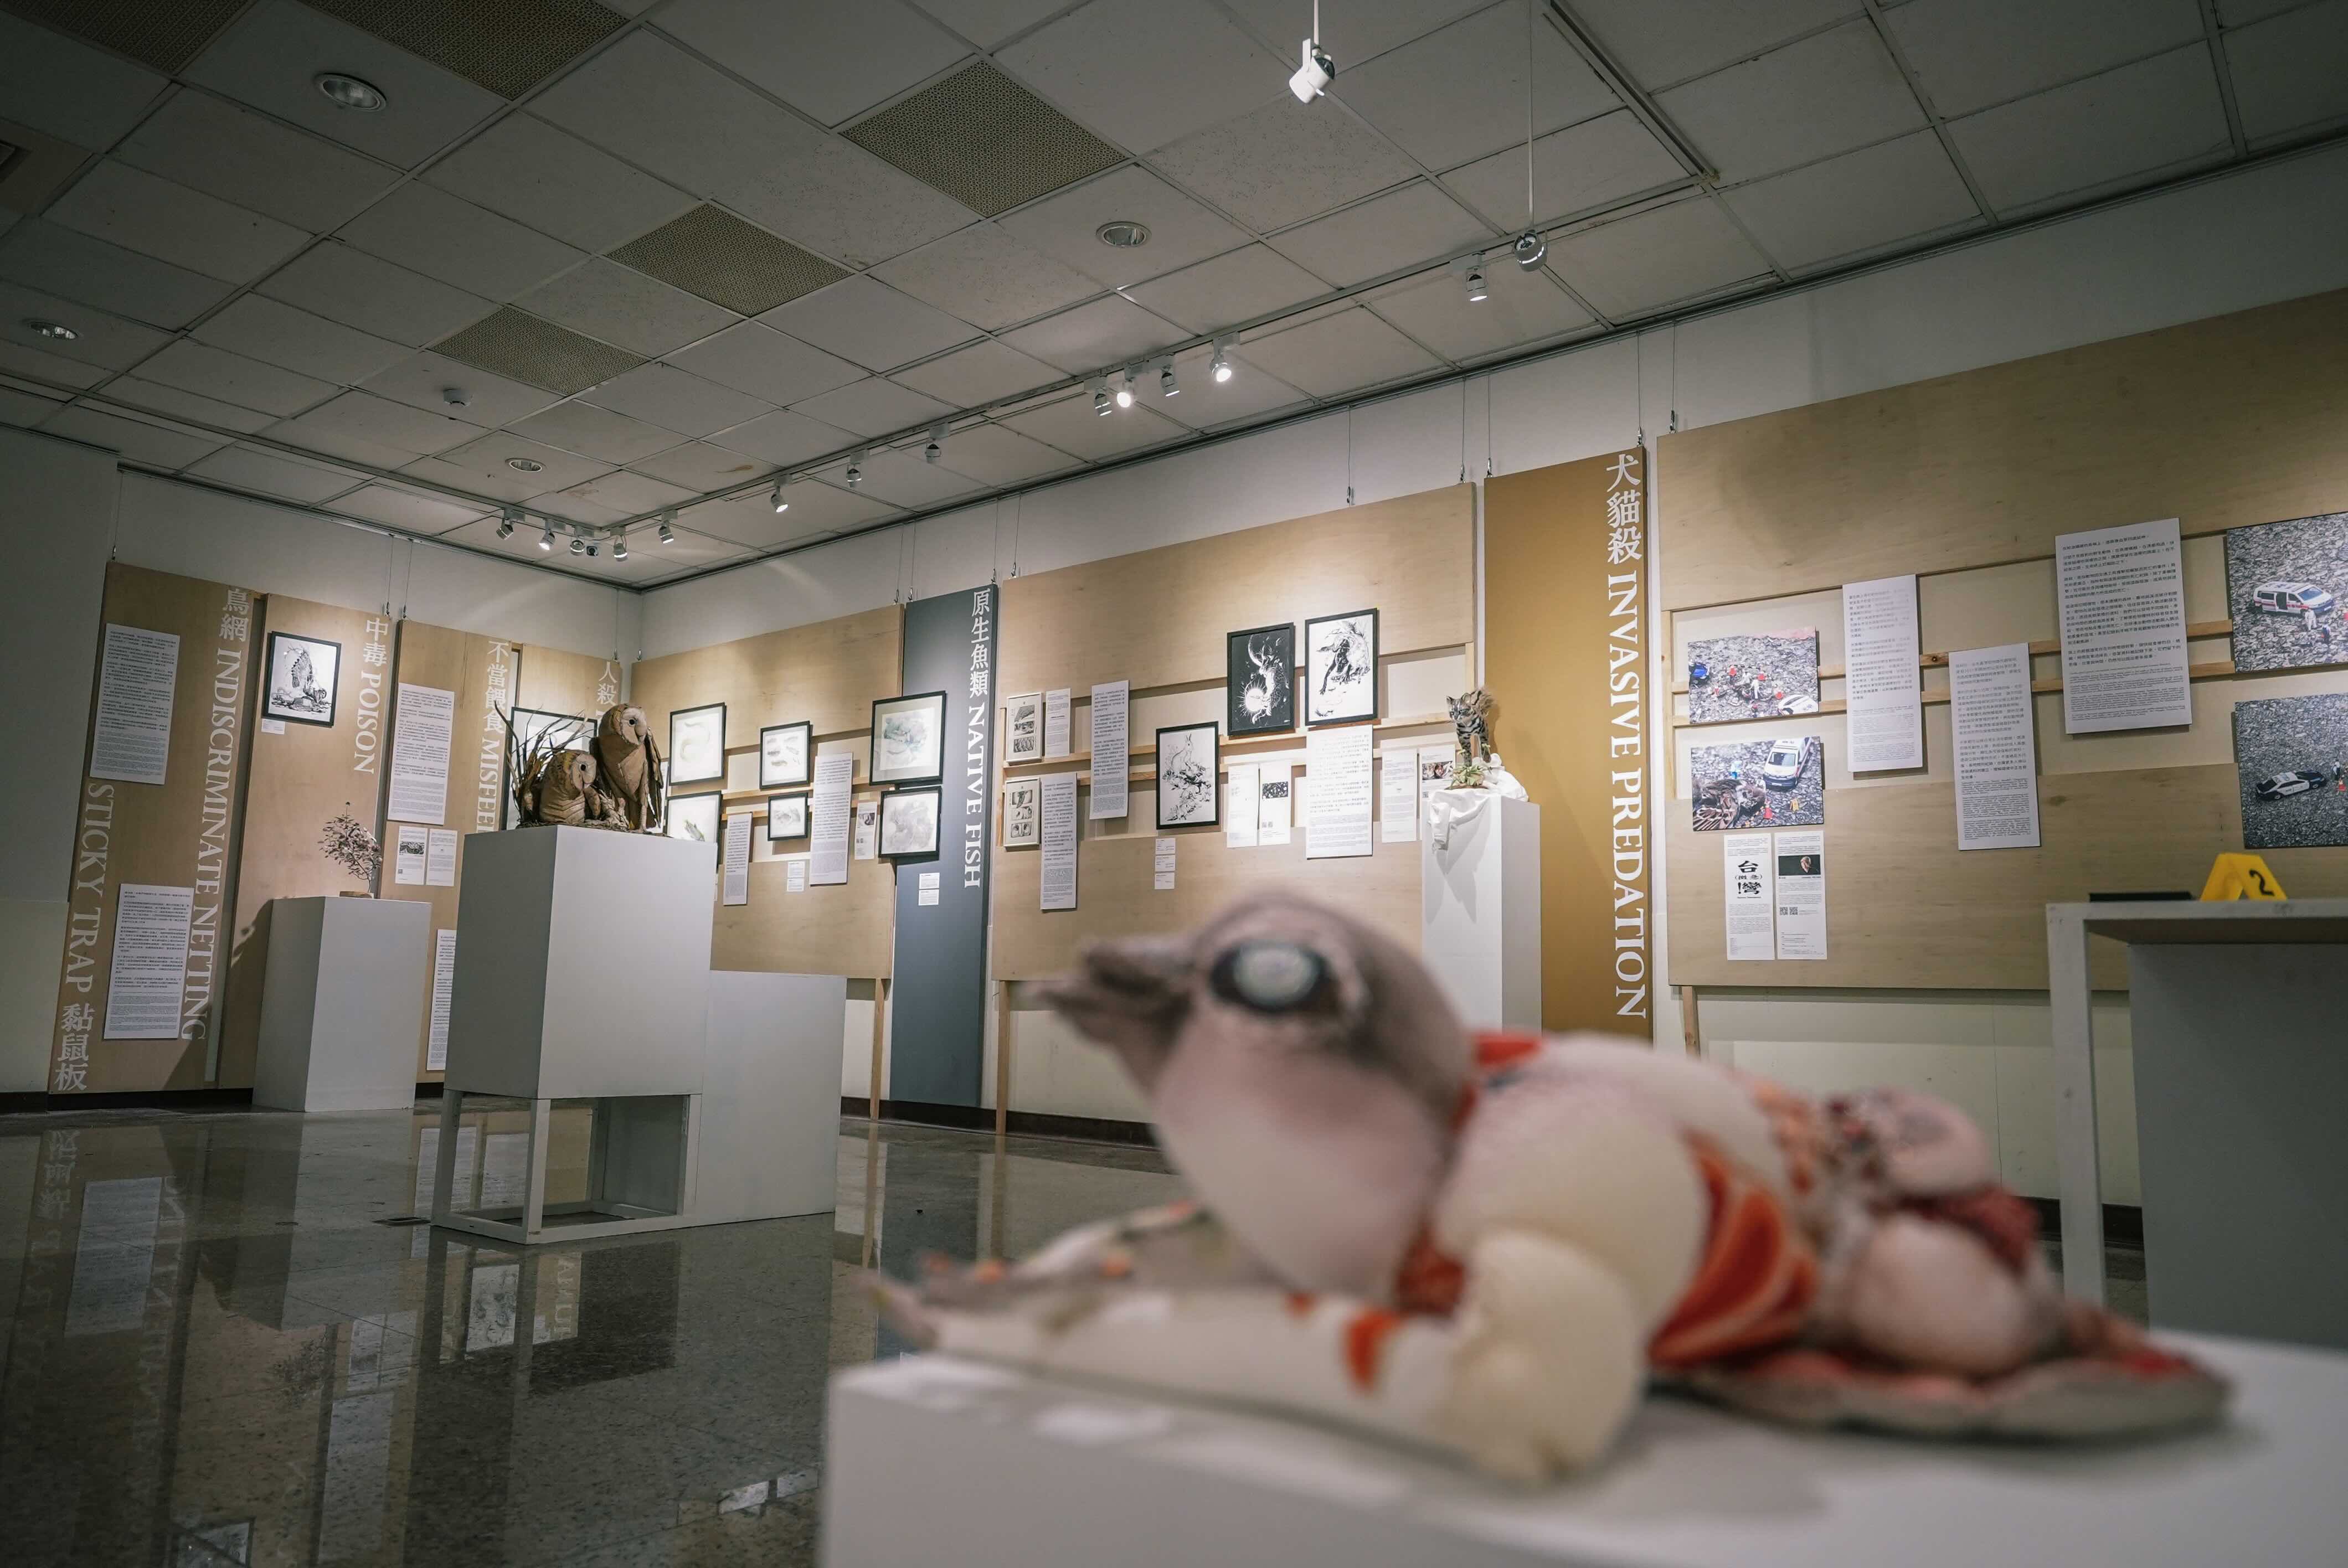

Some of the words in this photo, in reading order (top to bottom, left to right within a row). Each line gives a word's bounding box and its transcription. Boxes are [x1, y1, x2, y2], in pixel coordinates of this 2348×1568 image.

[1606, 453, 1642, 565] 犬貓殺
[219, 589, 249, 642] 鳥網
[363, 617, 389, 667] 中毒
[970, 588, 991, 699] 原生魚類
[1608, 570, 1641, 758] INVASIVE
[354, 672, 382, 773] POISON
[483, 641, 509, 735] 不當餵食
[596, 662, 617, 706] 人殺
[195, 648, 242, 894] INDISCRIMINATE
[966, 702, 986, 814] NATIVE
[76, 782, 114, 898] STICKY
[964, 822, 982, 888] FISH
[1738, 860, 1759, 873] 台
[2248, 869, 2275, 896] 2
[1612, 767, 1646, 1019] PREDATION
[65, 907, 102, 993] TRAP
[181, 904, 218, 1041] NETTING
[54, 1003, 95, 1091] 黏鼠板
